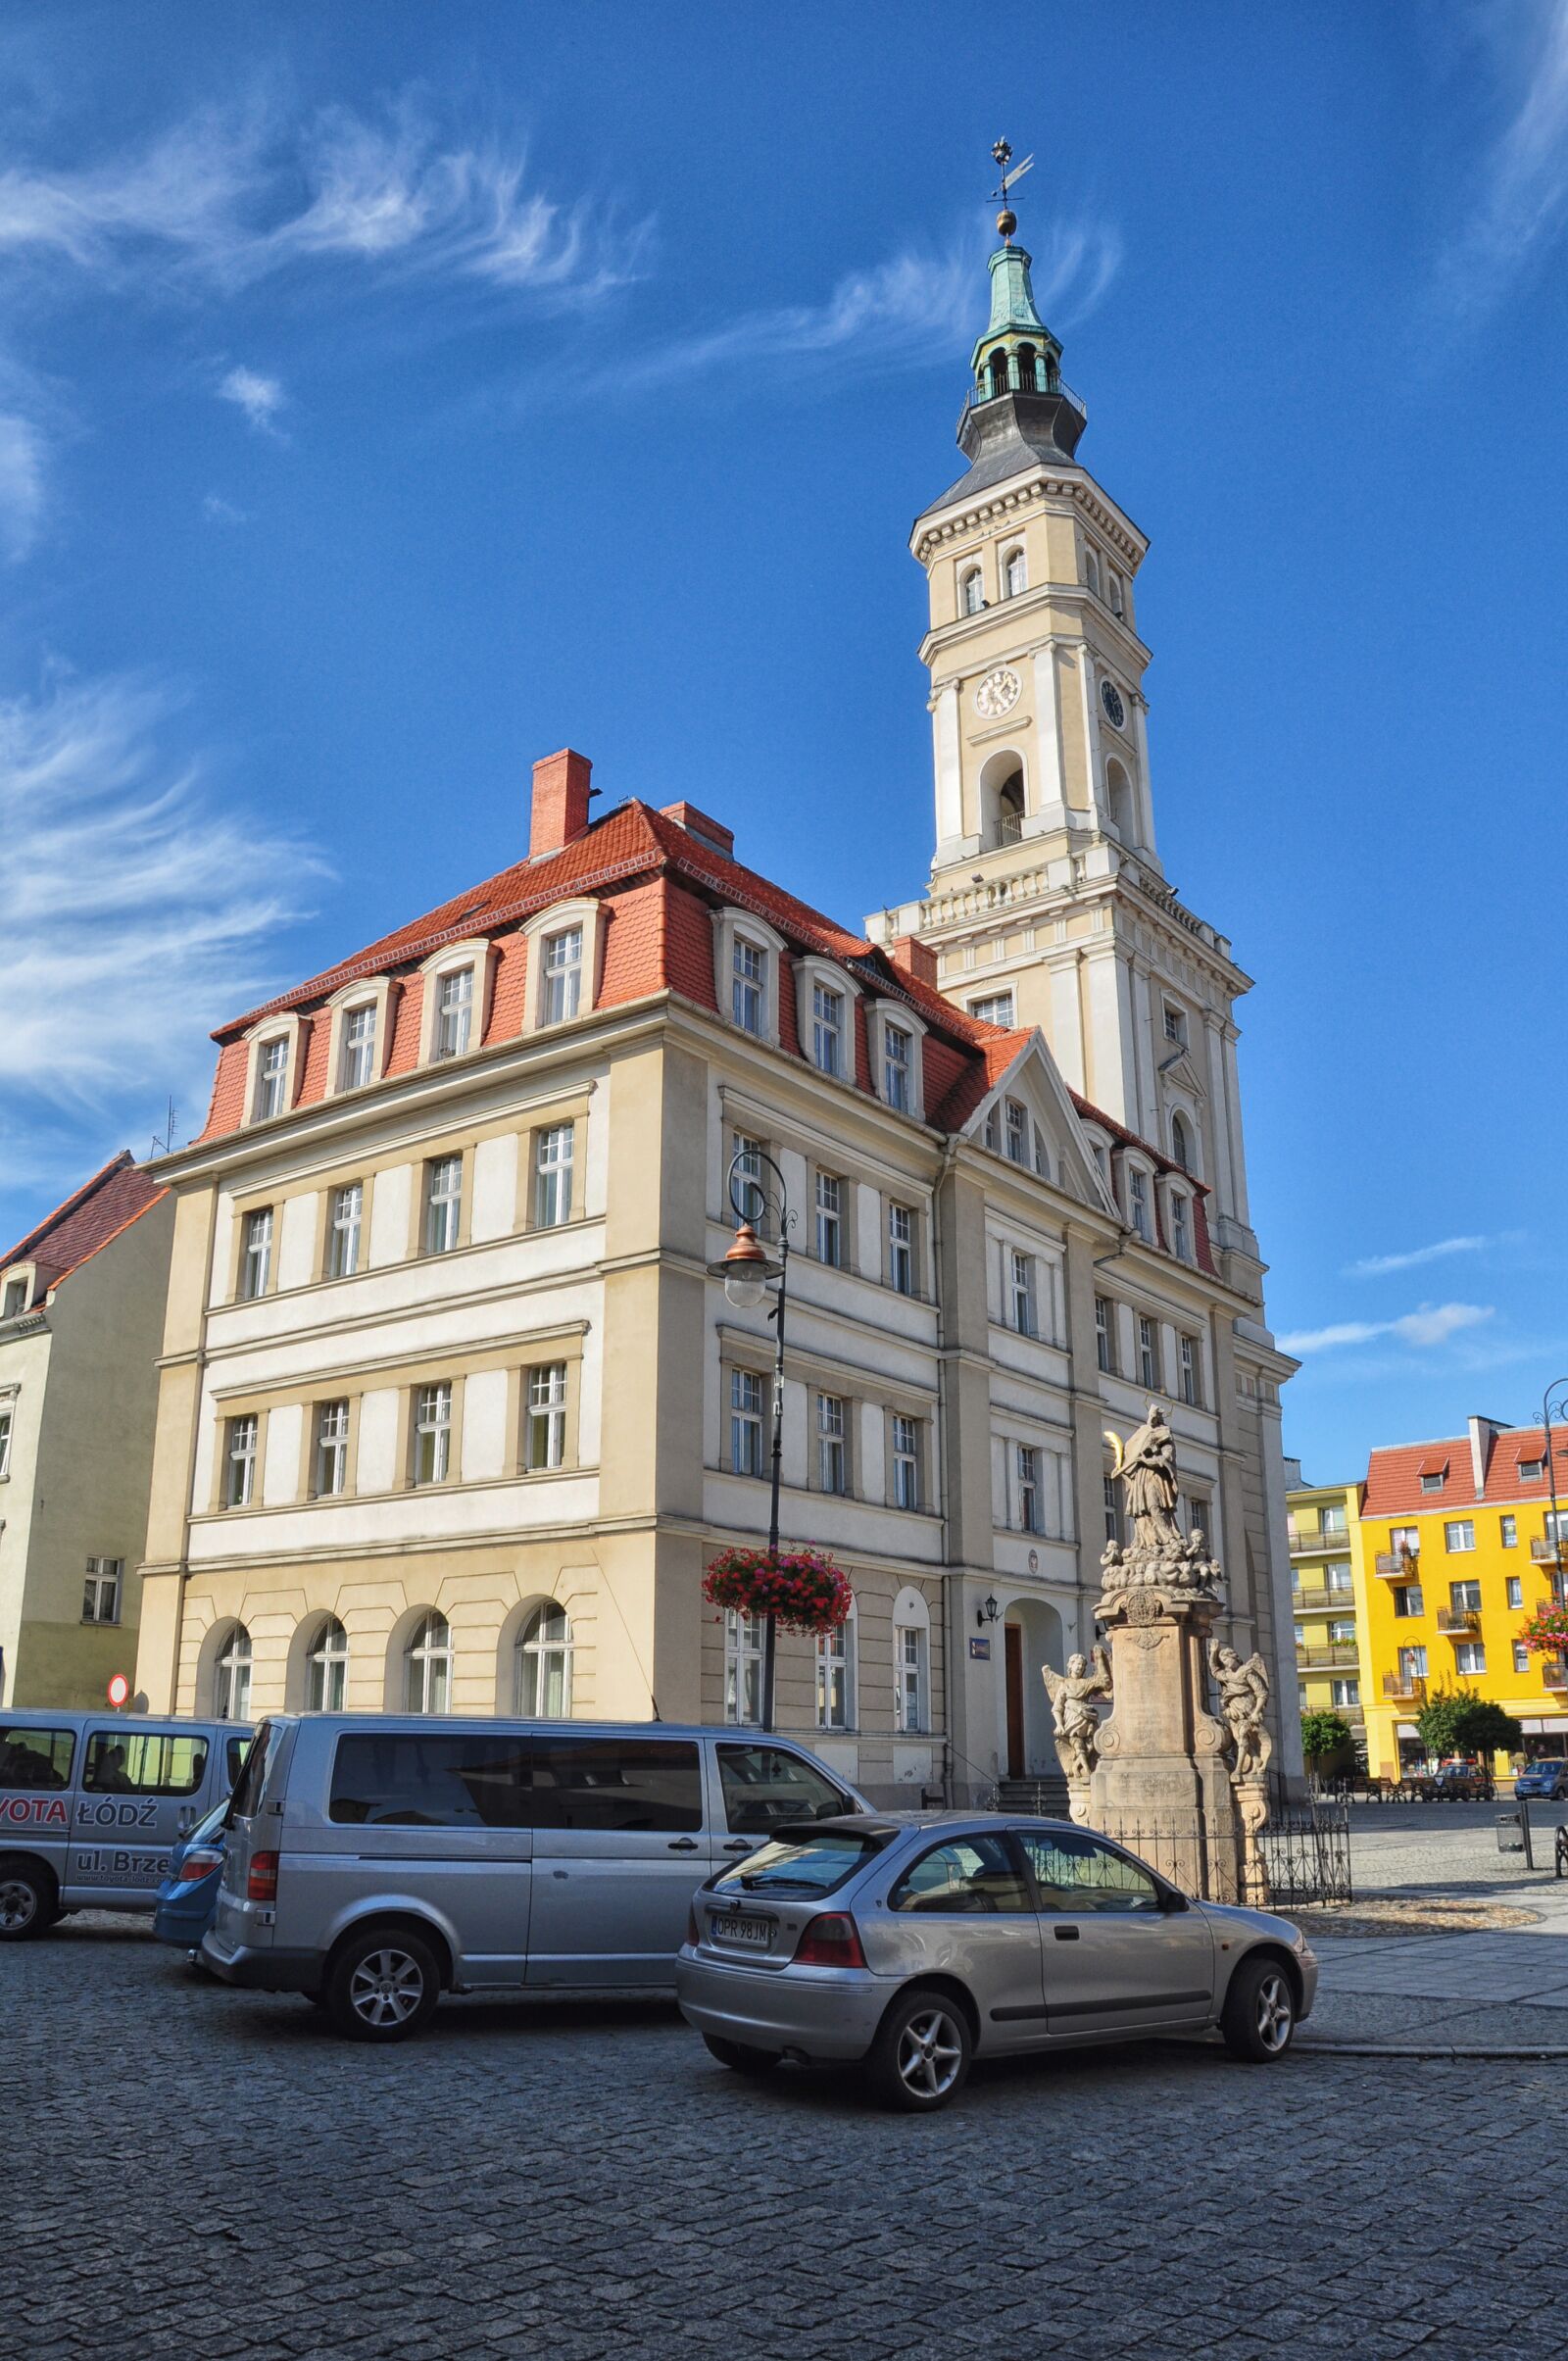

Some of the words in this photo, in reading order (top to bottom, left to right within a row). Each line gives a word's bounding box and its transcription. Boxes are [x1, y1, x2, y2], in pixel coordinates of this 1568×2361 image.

[77, 1795, 158, 1828] ŁÓDŹ
[77, 1850, 108, 1872] ul.
[717, 1918, 738, 1938] OPR
[741, 1921, 767, 1942] 98JM
